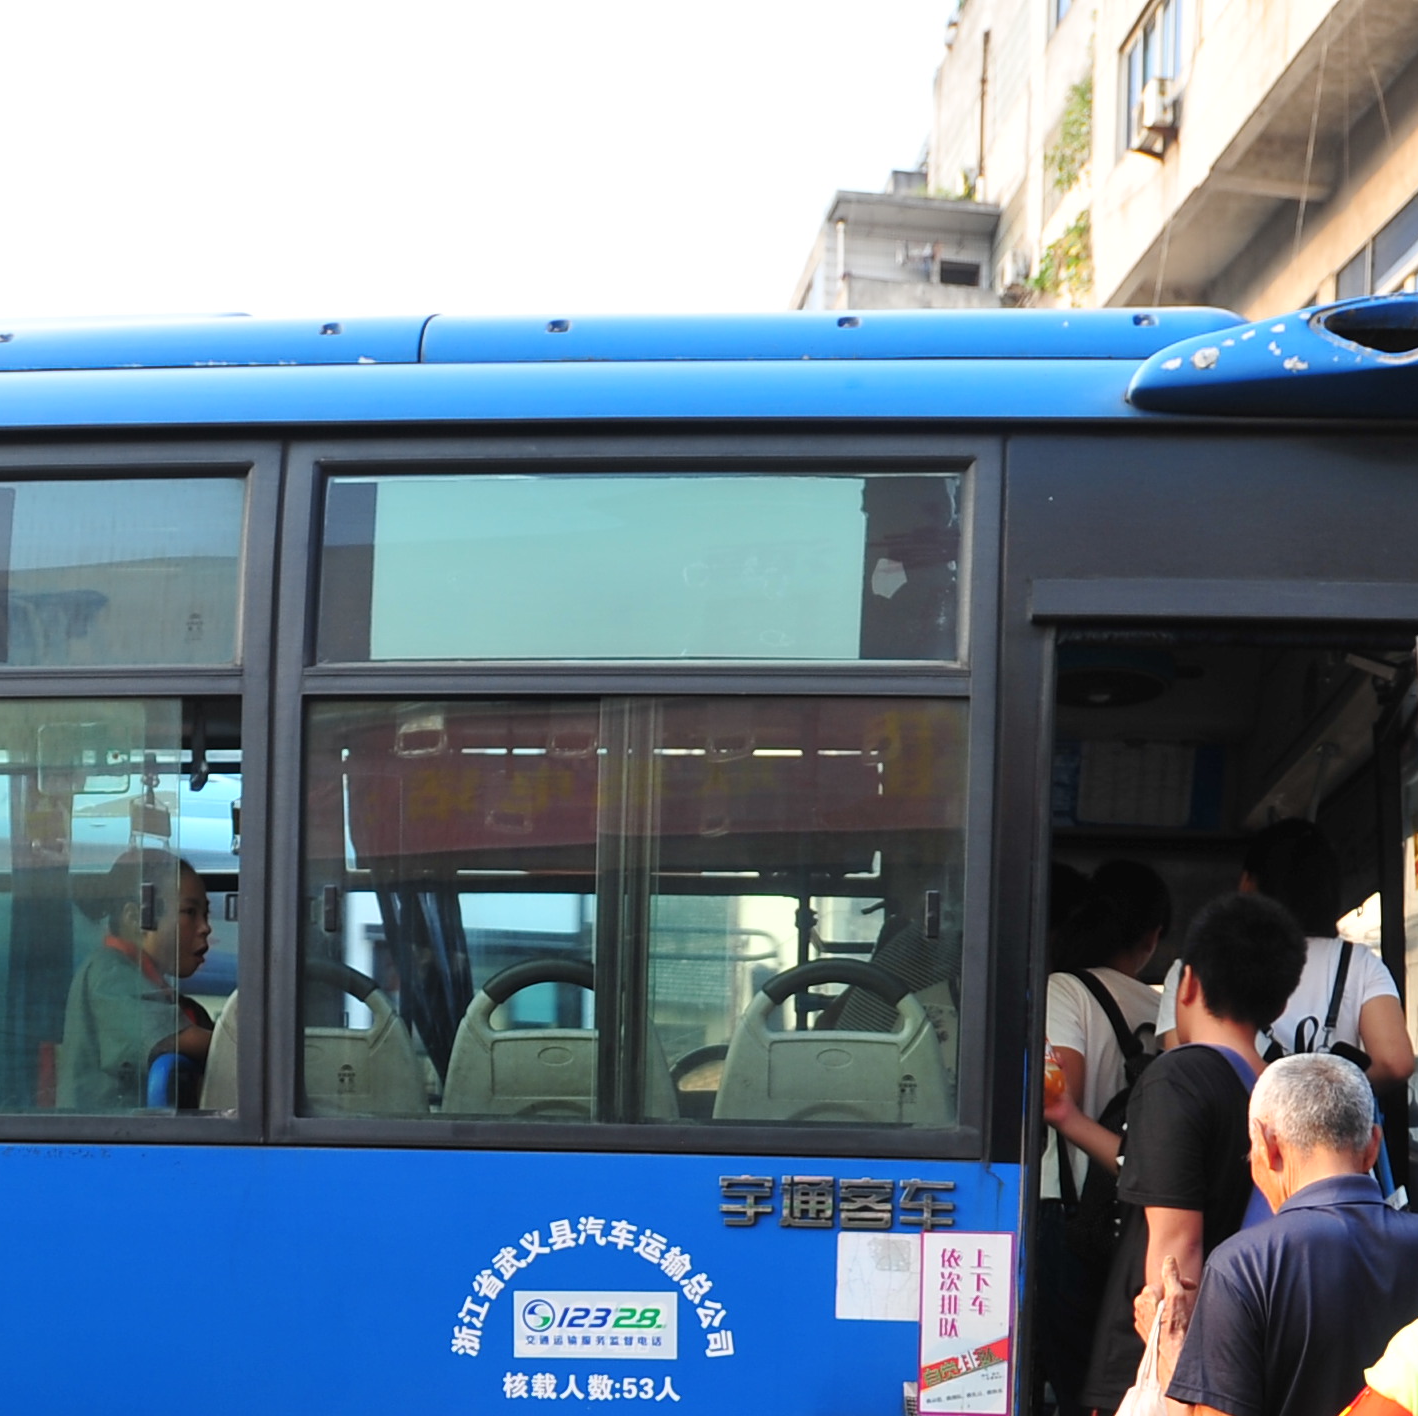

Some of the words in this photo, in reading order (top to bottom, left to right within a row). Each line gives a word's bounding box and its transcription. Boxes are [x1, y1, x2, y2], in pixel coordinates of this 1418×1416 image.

[719, 1174, 956, 1231] 宇通客车
[451, 1216, 734, 1357] 浙江省武义县汽车运输总公司
[939, 1248, 962, 1338] 依次排队
[969, 1248, 993, 1316] 上下车
[526, 1335, 662, 1346] 交通运输服务监督电话
[557, 1307, 662, 1329] 12328
[502, 1372, 681, 1402] 核载人数:53人
